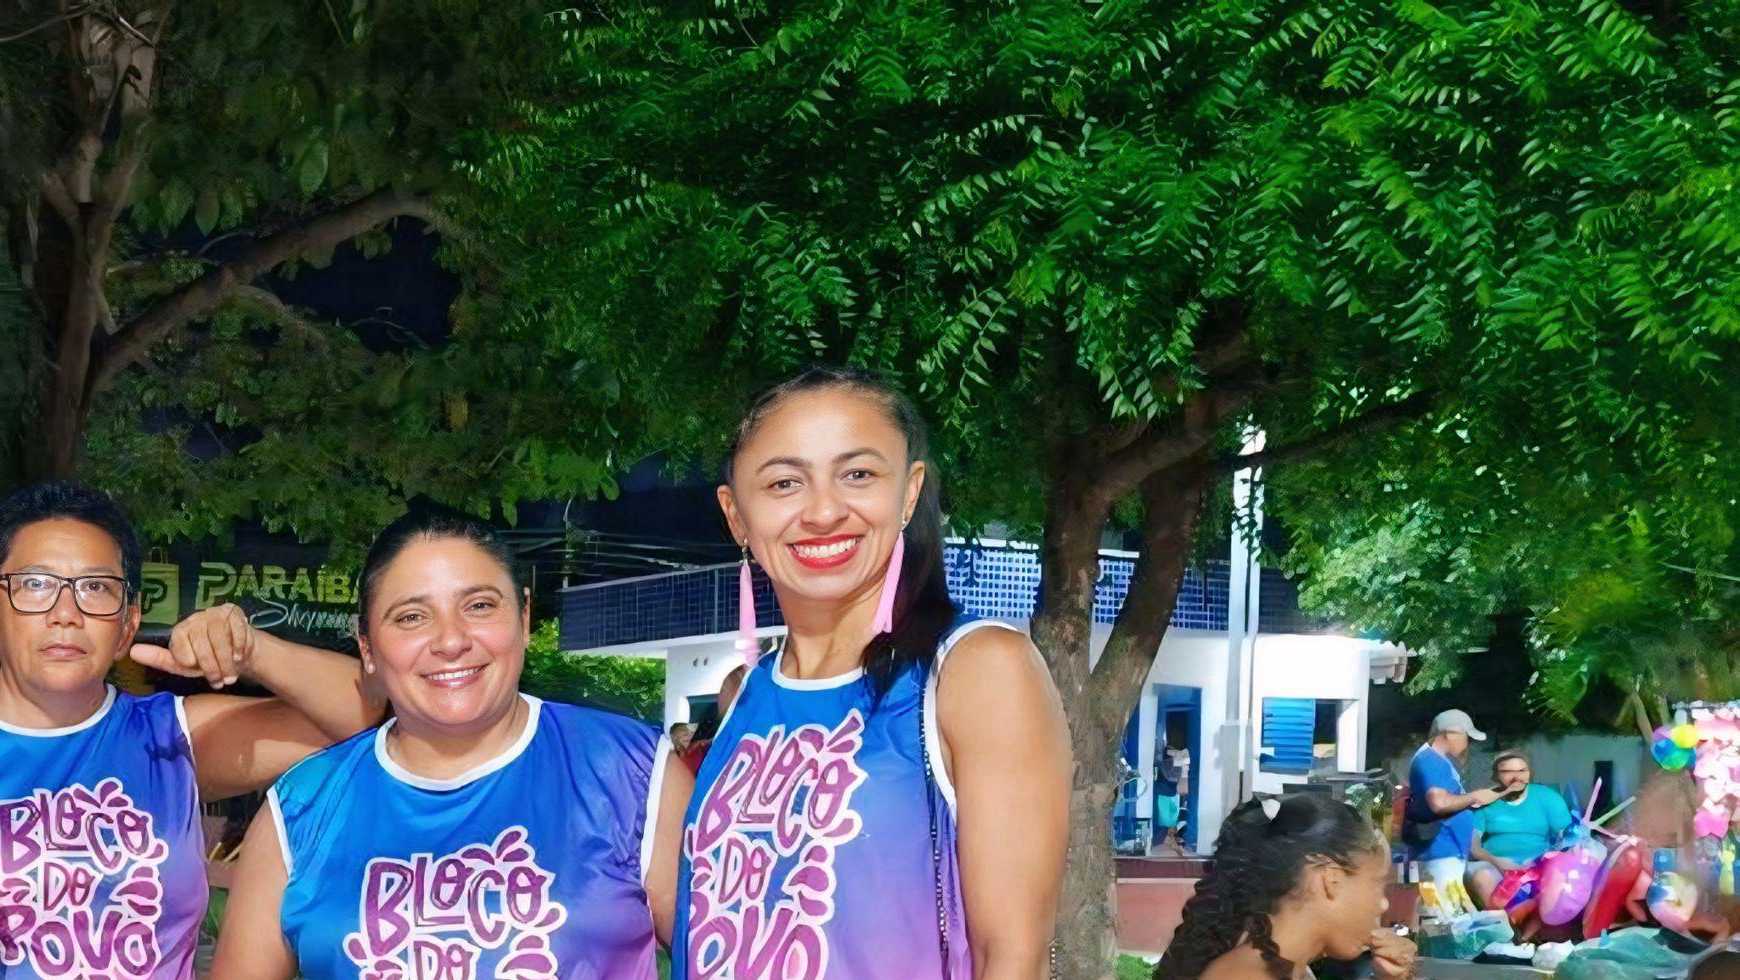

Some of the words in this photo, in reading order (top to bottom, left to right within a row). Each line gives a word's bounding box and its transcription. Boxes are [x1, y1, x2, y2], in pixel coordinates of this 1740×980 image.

[195, 562, 359, 610] PARAÍB
[696, 728, 858, 854] BLOCO
[43, 861, 94, 911] DO
[718, 836, 771, 902] DO
[363, 855, 547, 958] BLOCO
